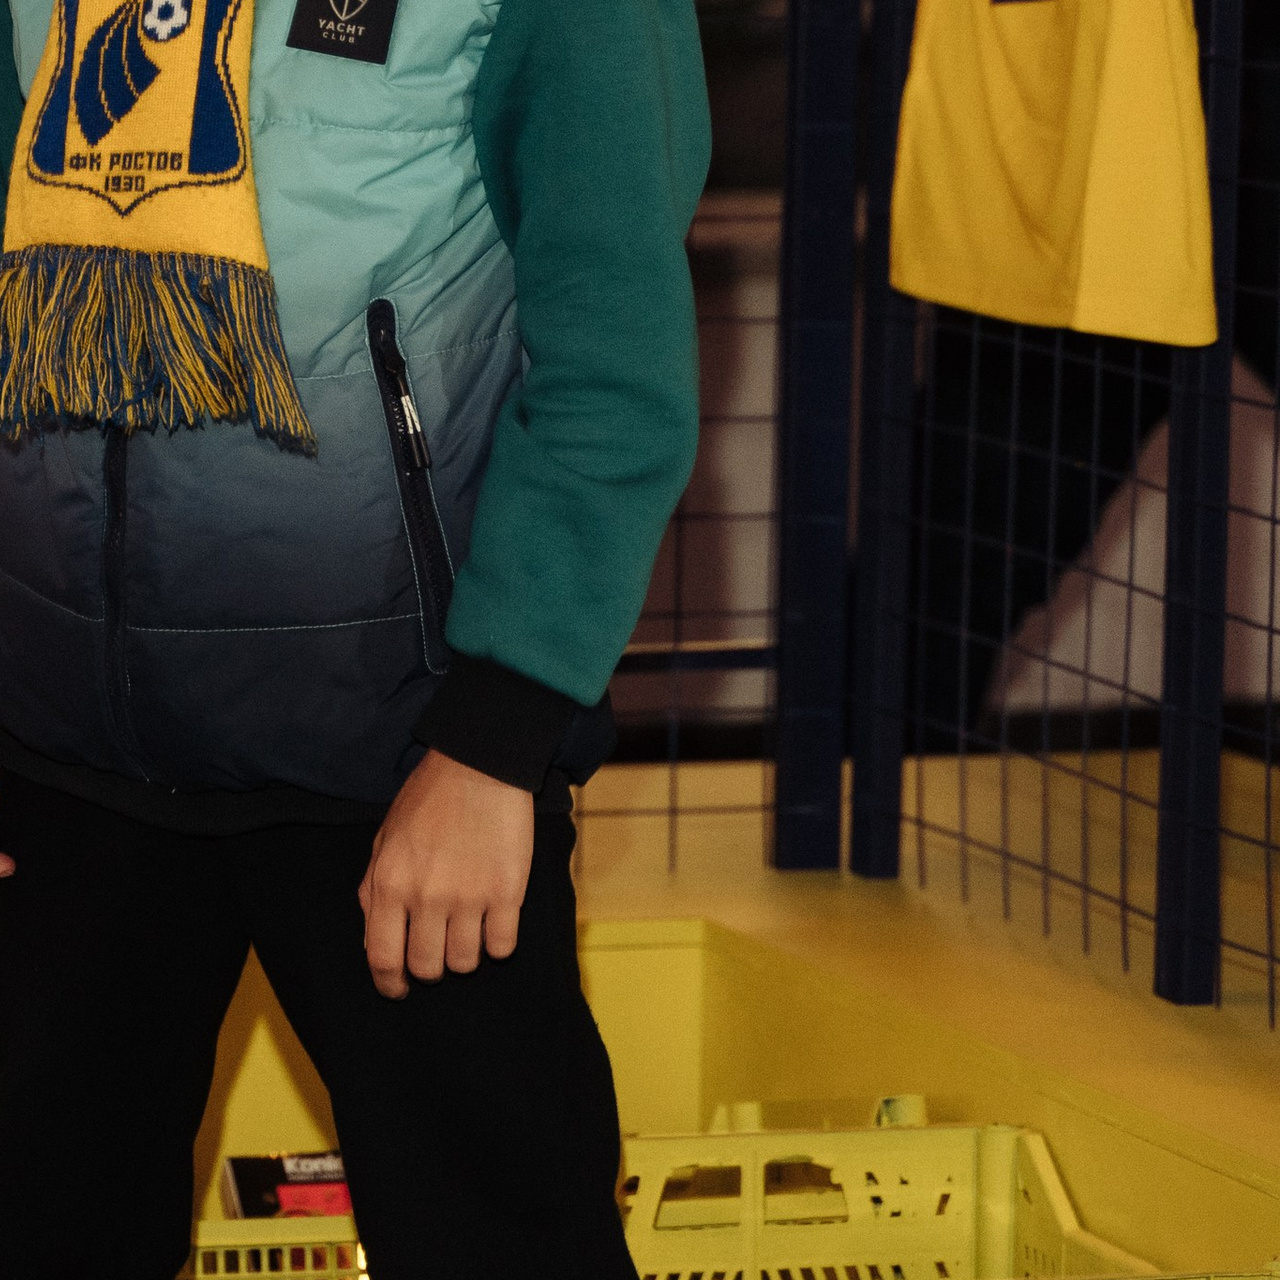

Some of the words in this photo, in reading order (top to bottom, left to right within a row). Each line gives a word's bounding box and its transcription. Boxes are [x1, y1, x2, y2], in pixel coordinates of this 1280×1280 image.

[318, 18, 366, 36] YACHT
[322, 31, 355, 44] CLUB
[69, 152, 101, 172] ФК
[108, 151, 183, 172] РОСТОВ
[104, 175, 146, 193] 1930
